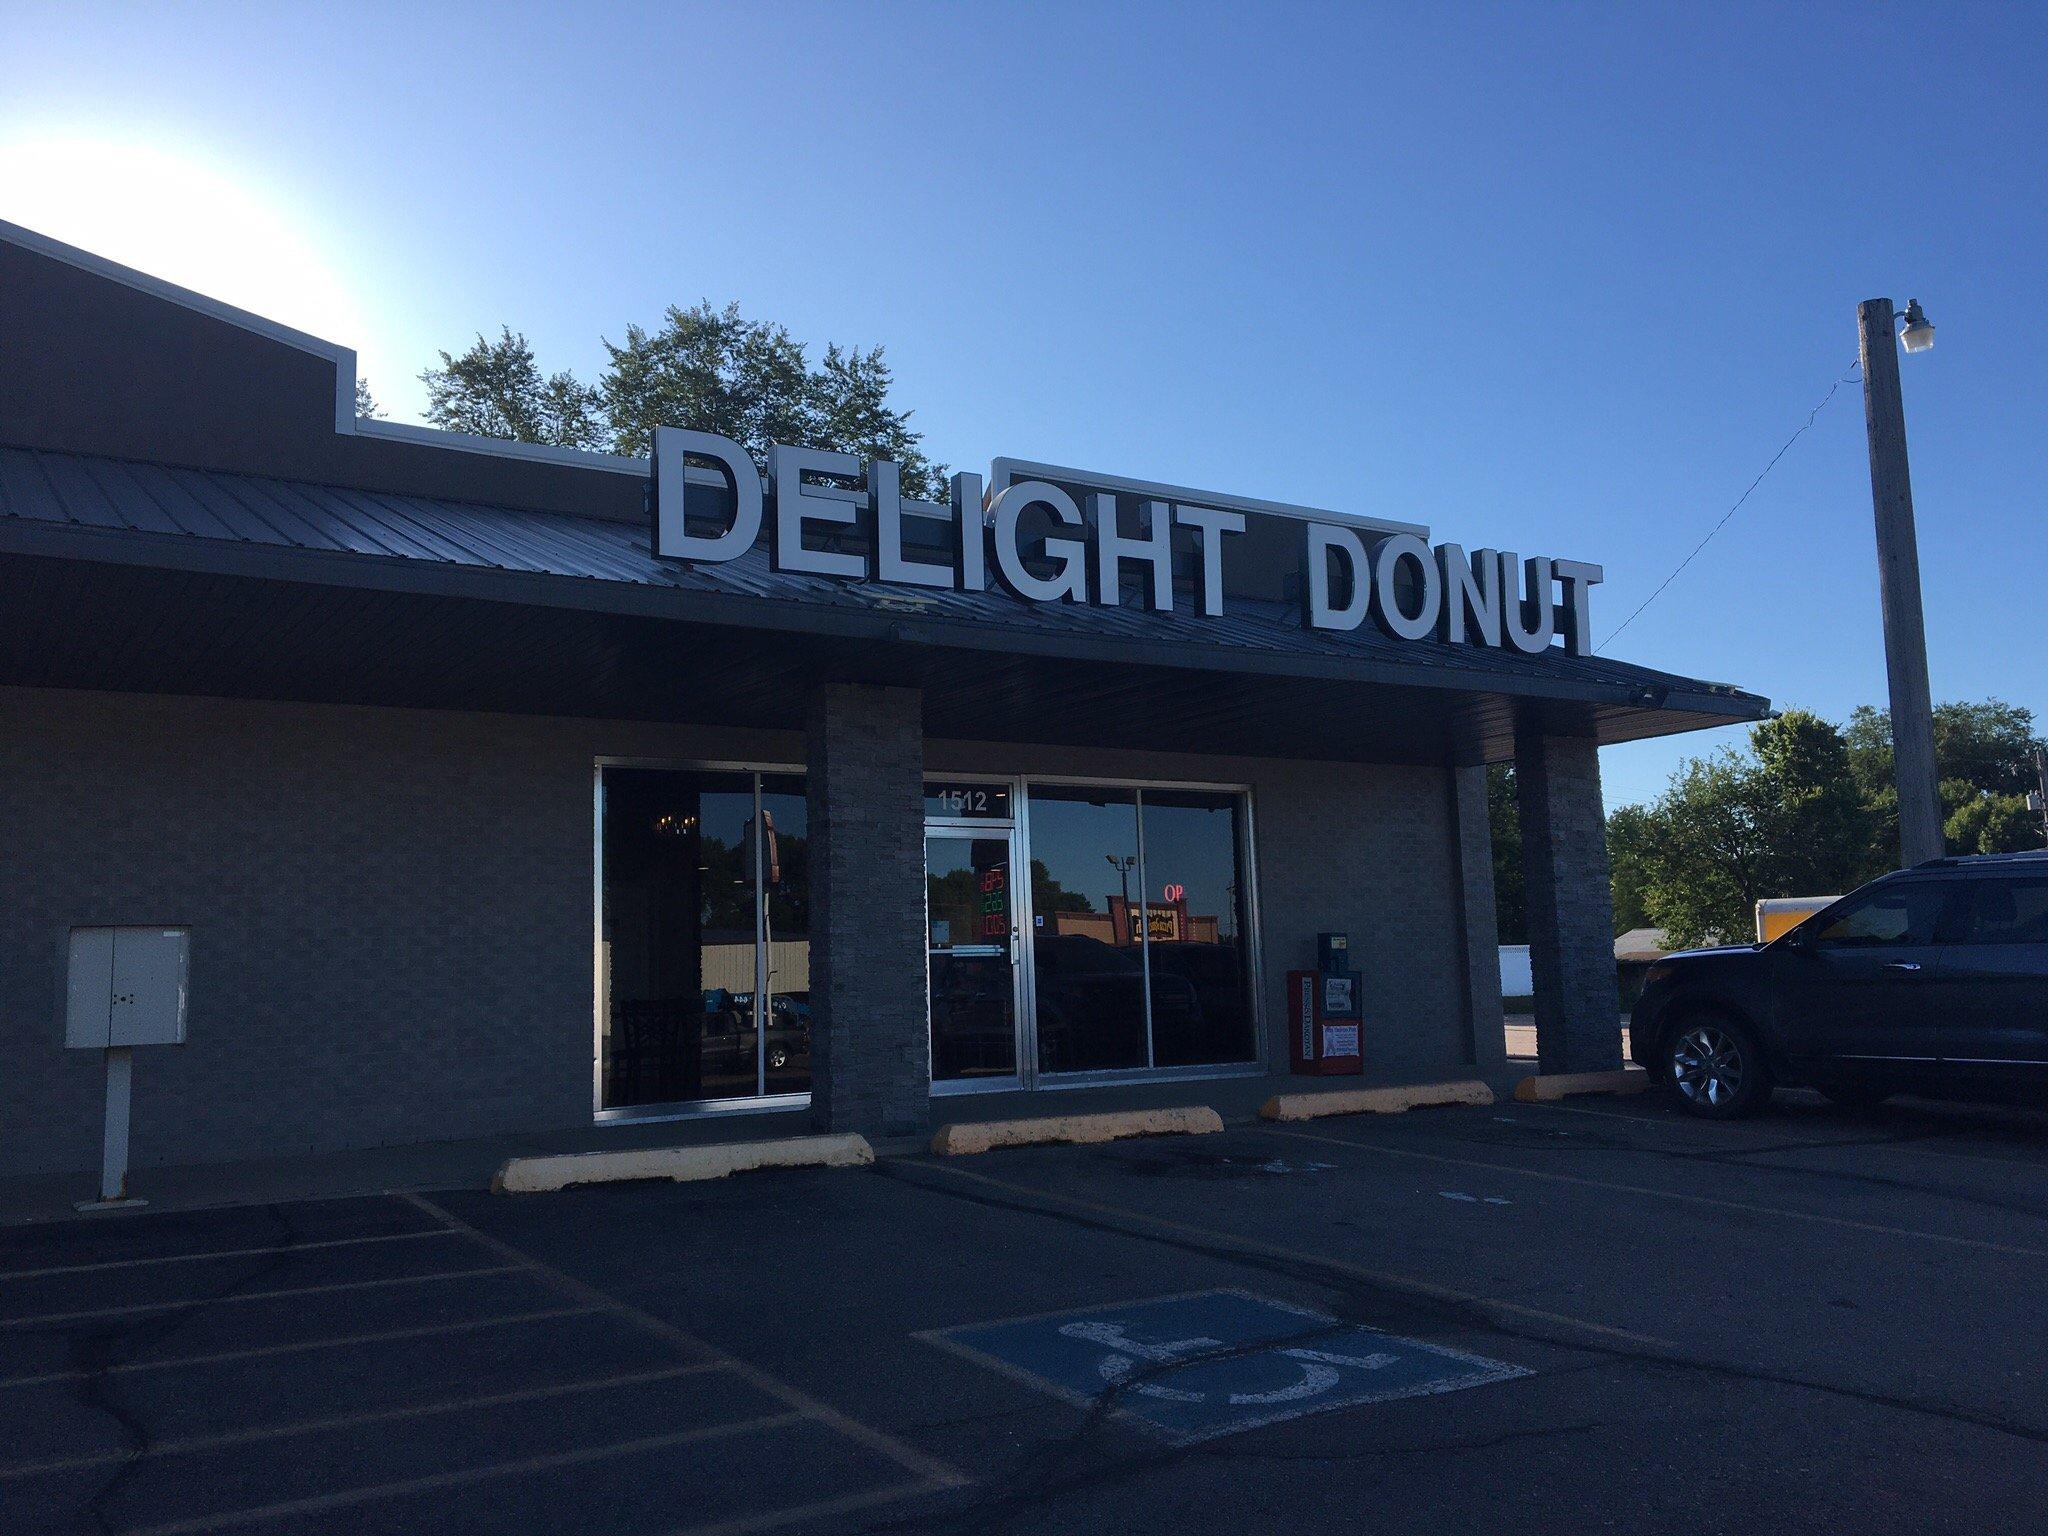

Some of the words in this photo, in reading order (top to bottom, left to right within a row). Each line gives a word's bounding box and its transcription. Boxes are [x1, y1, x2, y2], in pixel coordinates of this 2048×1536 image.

[652, 425, 1246, 618] DELIGHT
[1307, 522, 1603, 658] DONUT
[939, 790, 987, 812] 1512
